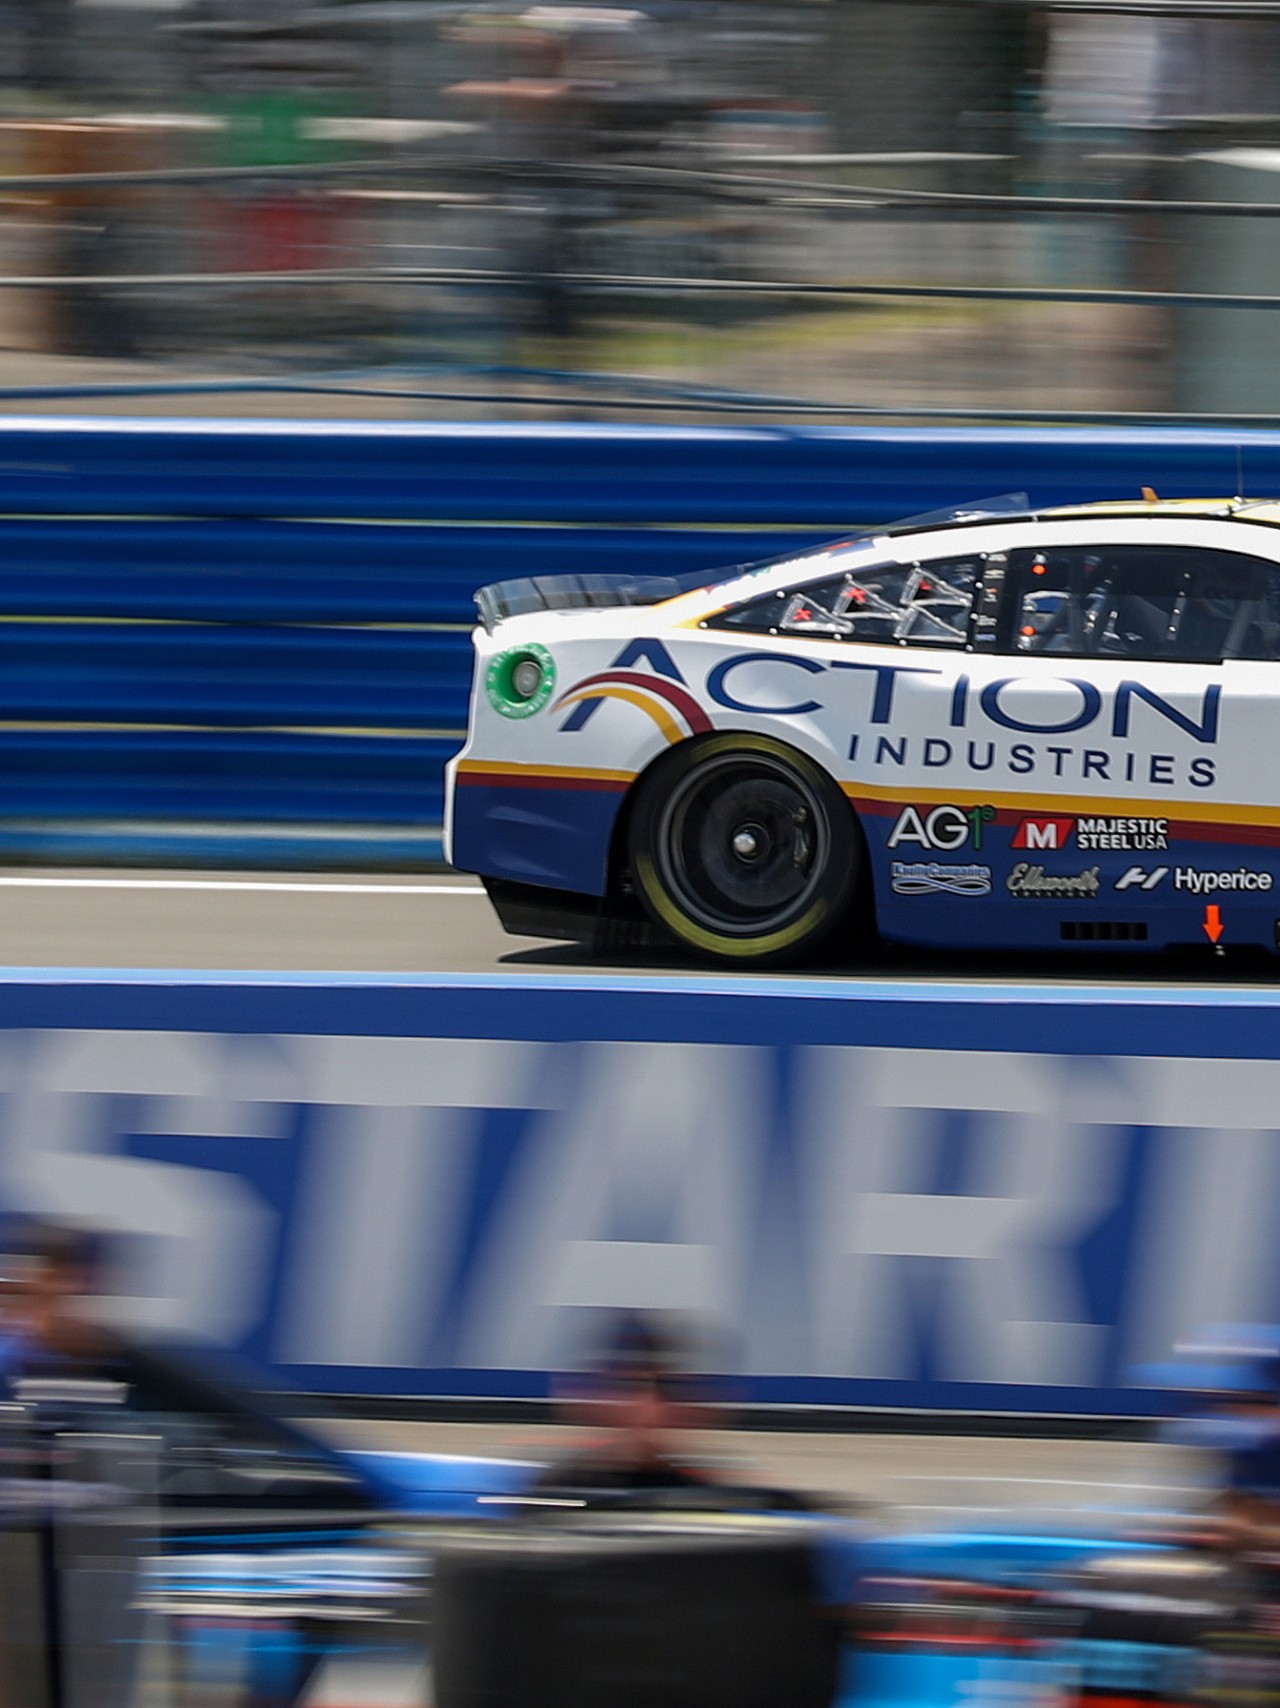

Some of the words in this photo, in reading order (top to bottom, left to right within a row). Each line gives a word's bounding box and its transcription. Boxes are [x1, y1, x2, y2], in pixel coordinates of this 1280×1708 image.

[558, 637, 1222, 744] ACTION
[847, 733, 1218, 788] INDUSTRIES
[1076, 818, 1168, 835] MAJESTIC
[1077, 833, 1132, 850] STEEL
[1134, 834, 1168, 850] USA
[1175, 866, 1273, 894] Hyperice
